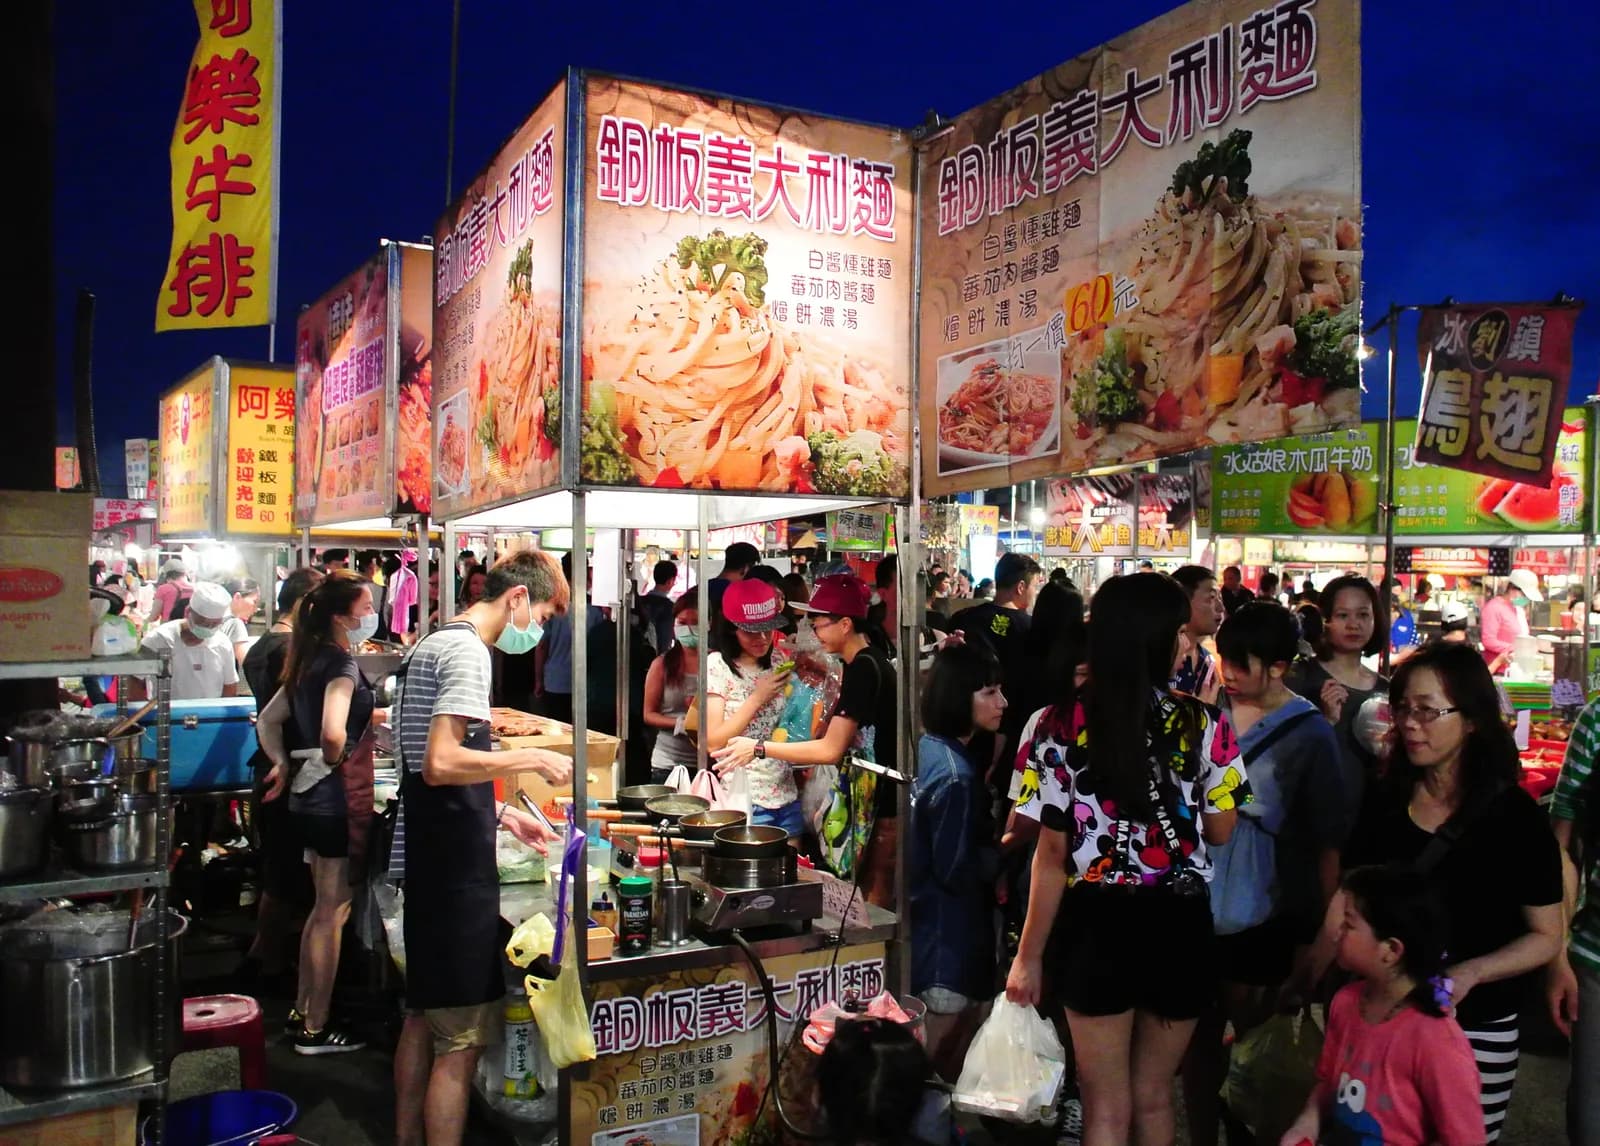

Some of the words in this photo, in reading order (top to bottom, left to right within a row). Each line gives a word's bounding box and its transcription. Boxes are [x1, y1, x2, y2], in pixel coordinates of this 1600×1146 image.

[599, 118, 895, 240] 銅板義大利麵
[939, 1, 1316, 235] 銅板義大利麵
[437, 126, 554, 308] 銅板義大利麵
[260, 511, 274, 522] 60
